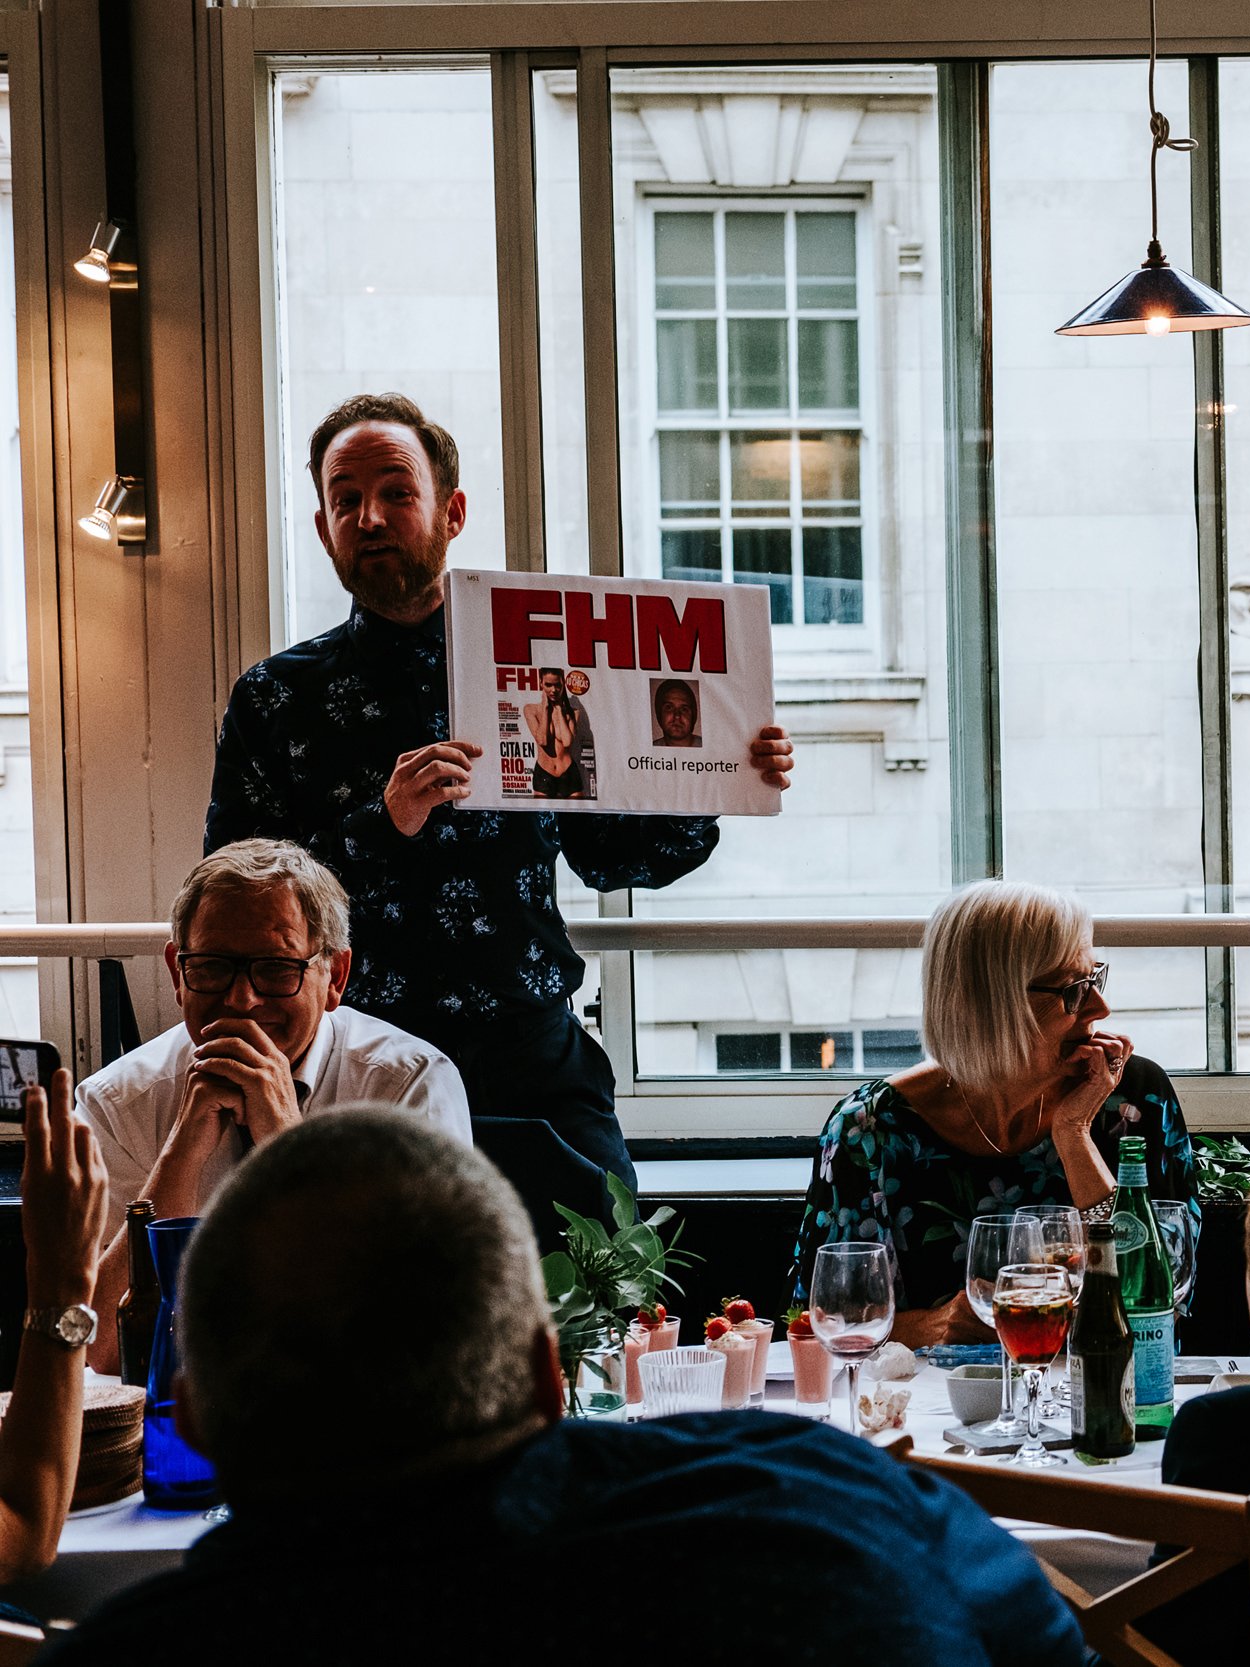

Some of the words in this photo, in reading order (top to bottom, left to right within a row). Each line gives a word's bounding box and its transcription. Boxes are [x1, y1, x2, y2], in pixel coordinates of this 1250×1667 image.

[491, 587, 727, 674] FHM
[496, 667, 543, 692] FH
[500, 742, 521, 758] CITA
[523, 742, 535, 758] EN
[628, 756, 677, 771] Official
[682, 760, 739, 774] reporter
